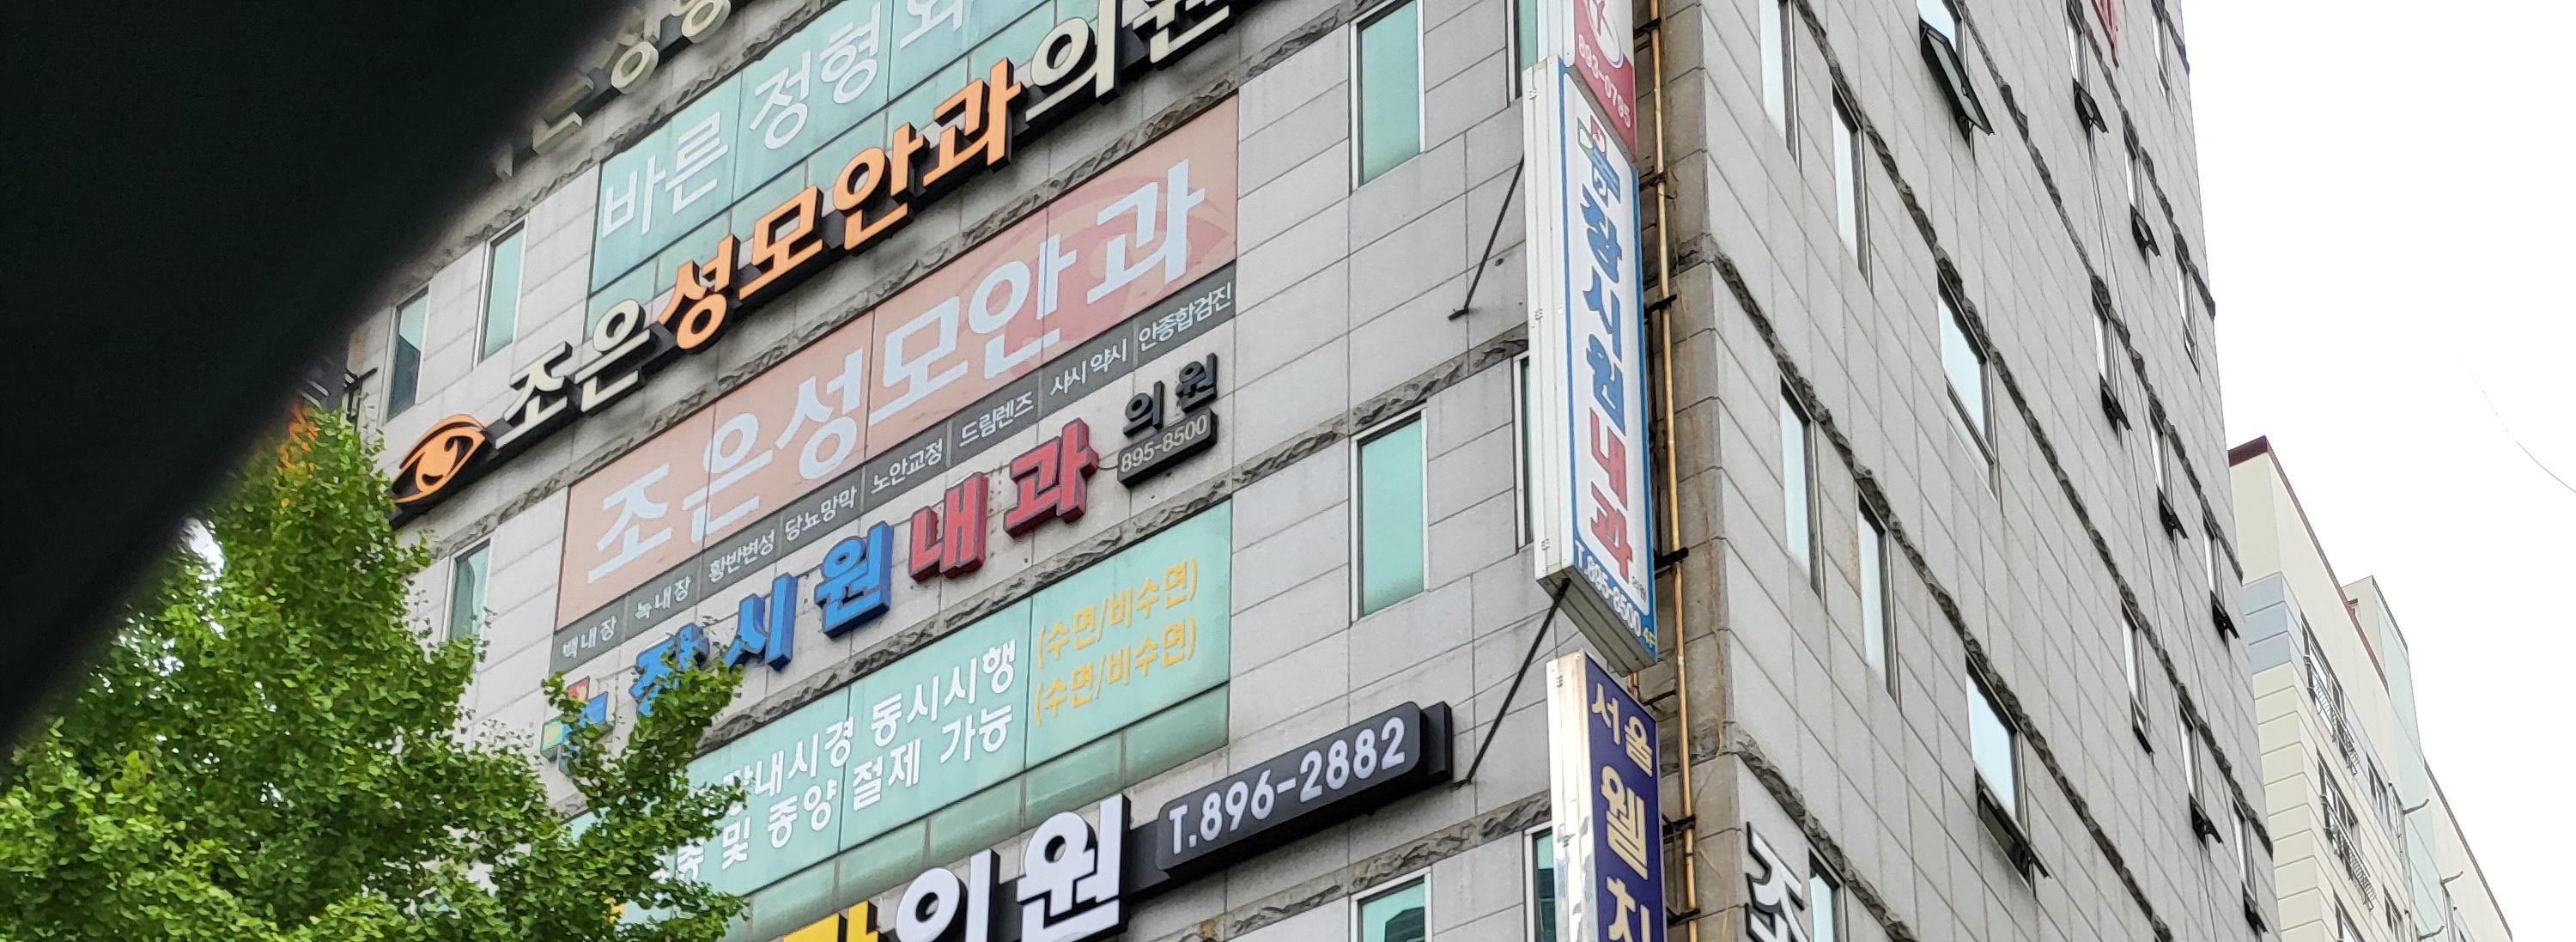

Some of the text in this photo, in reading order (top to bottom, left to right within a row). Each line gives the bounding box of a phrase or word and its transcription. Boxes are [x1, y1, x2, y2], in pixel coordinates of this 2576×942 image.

[587, 159, 1206, 584] 조은성모안과
[1120, 414, 1209, 474] 895-8500
[1122, 352, 1218, 438] 의원
[562, 615, 617, 659] 백내장
[708, 528, 775, 584] 황반변성
[784, 485, 858, 542] 당뇨망막
[871, 438, 944, 495] 노안교정
[959, 391, 1035, 447] 드림렌즈
[1139, 281, 1231, 352] 안종합검진
[870, 639, 1017, 747] 동시시행
[1036, 556, 1198, 668] (수면/비수면)
[1591, 683, 1653, 777] 서울
[721, 816, 752, 872] 및
[767, 775, 839, 849] 종양
[853, 737, 922, 811] 절제
[939, 703, 1014, 766] 가능
[1034, 614, 1198, 727] (수면/비수면)
[1168, 716, 1406, 855] T.896-2882
